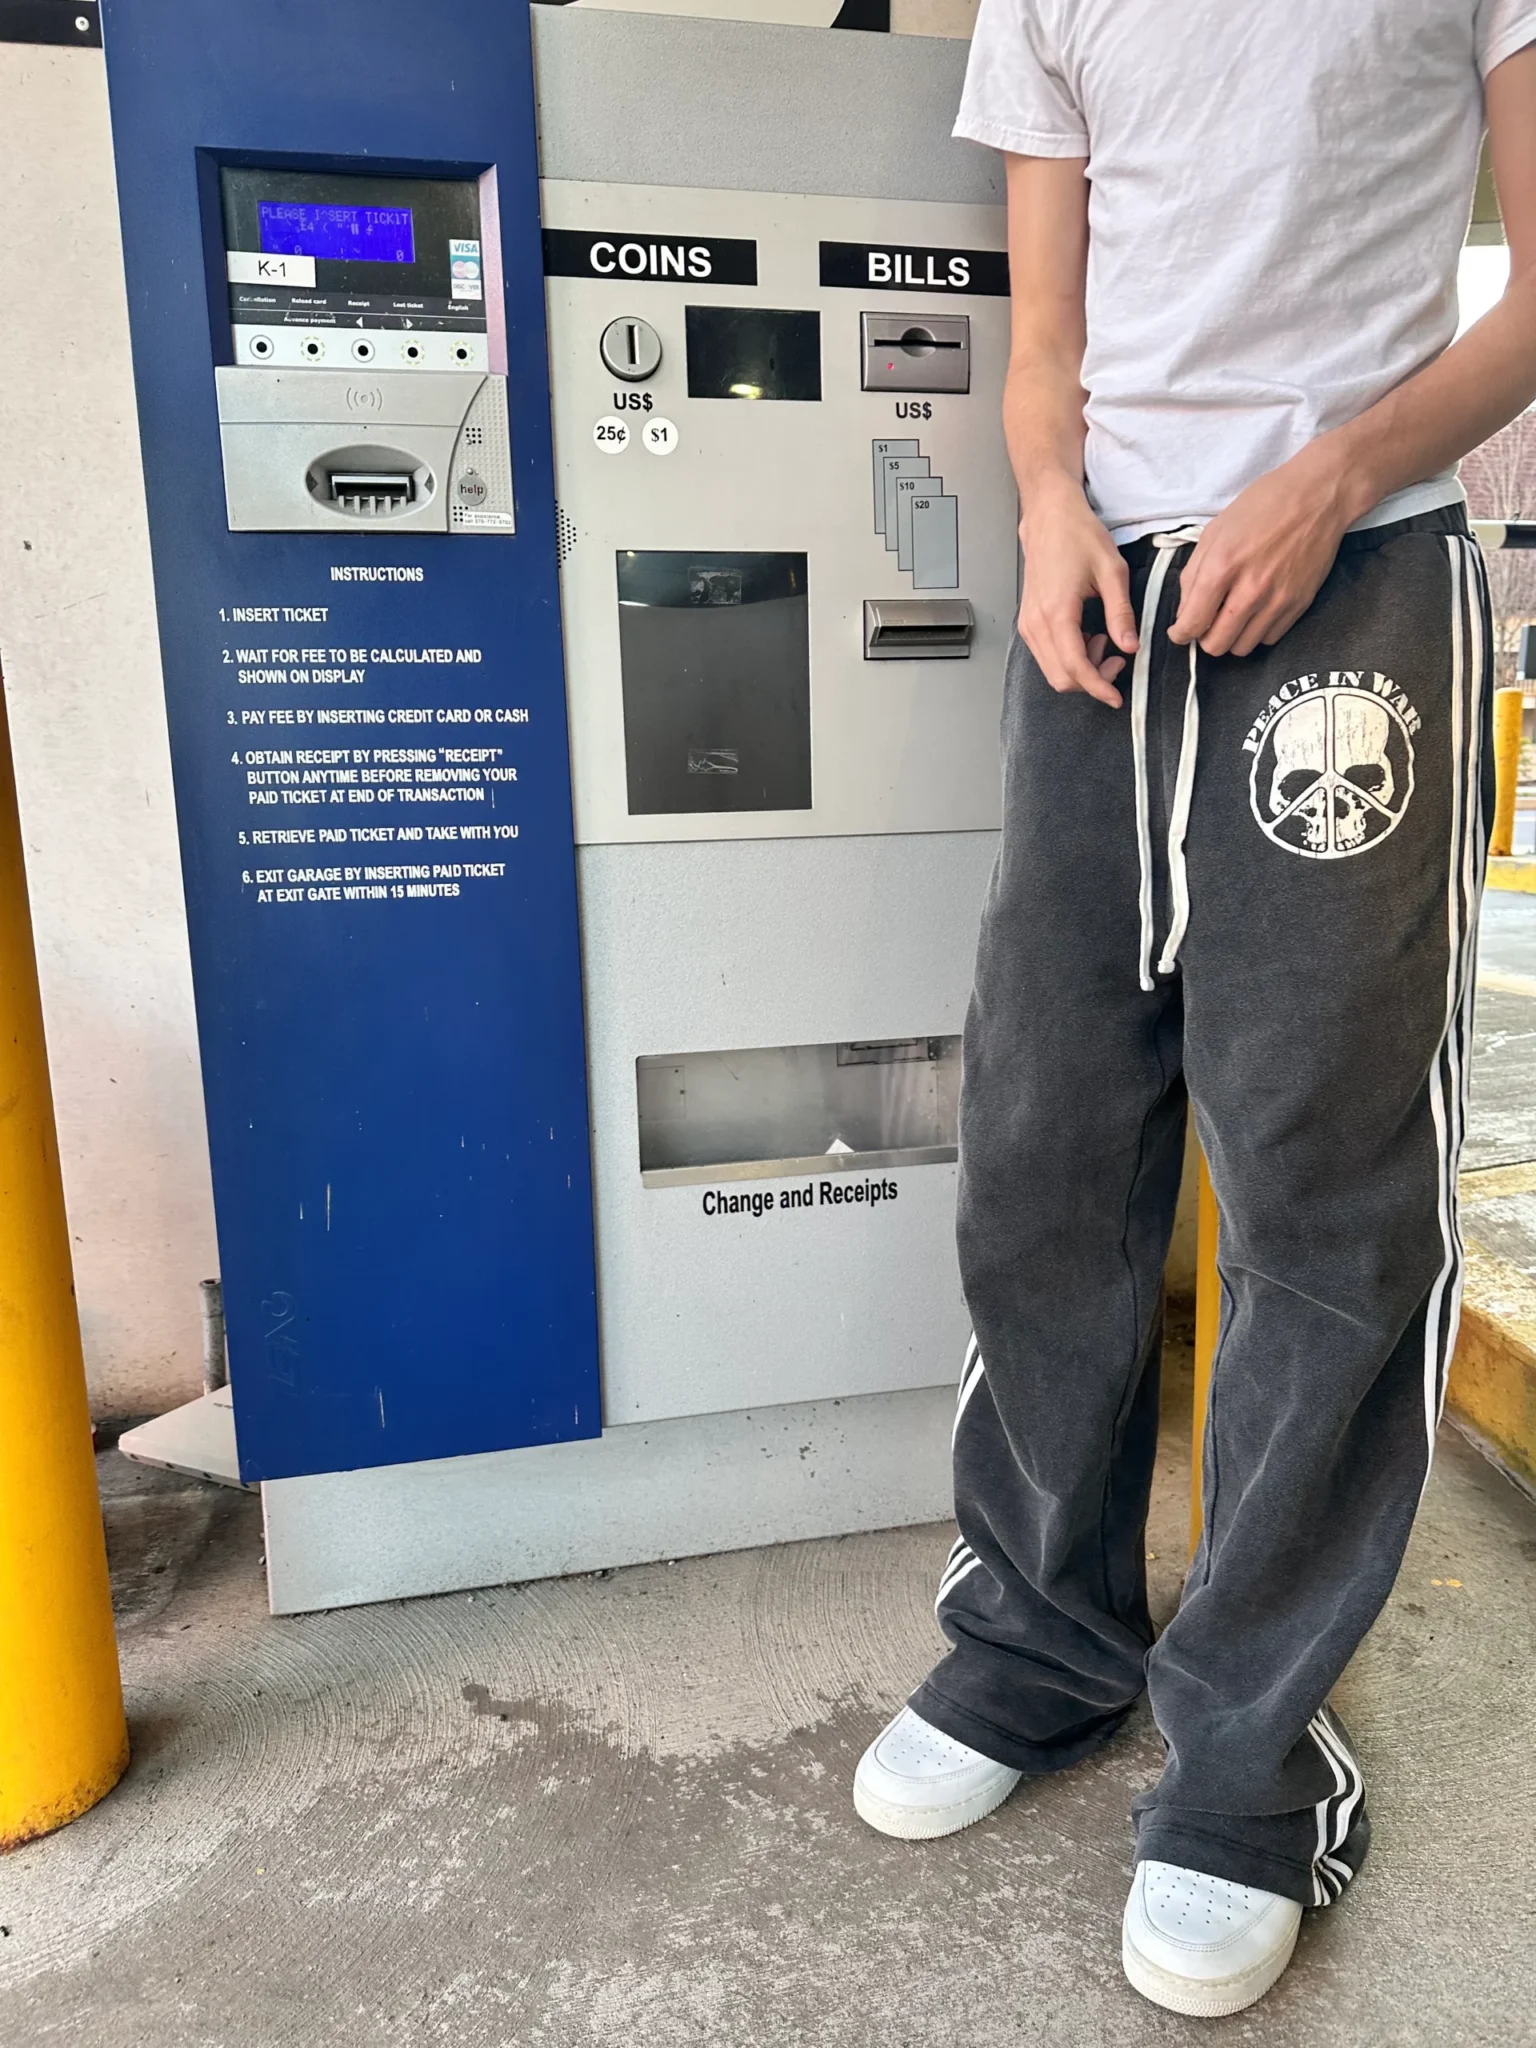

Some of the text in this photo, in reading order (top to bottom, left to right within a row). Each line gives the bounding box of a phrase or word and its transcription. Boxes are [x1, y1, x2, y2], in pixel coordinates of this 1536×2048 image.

[261, 206, 306, 220] PLEASE
[454, 243, 478, 253] VISA
[589, 241, 712, 278] COINS
[258, 260, 287, 277] K-1
[868, 252, 970, 287] BILLS
[613, 391, 653, 413] US$
[895, 401, 932, 421] US$
[596, 425, 626, 442] 25¢
[651, 427, 668, 443] $1
[878, 444, 888, 453] $1
[889, 461, 900, 470] $5
[460, 484, 484, 496] help
[899, 481, 915, 490] $10
[914, 500, 930, 509] $20
[330, 566, 424, 582] INSTRUCTIONS
[218, 607, 329, 622] 1. INSERT TICKET
[221, 648, 482, 663] 2. WAIT FOR FEE TO BE CALCULATED AND
[237, 669, 366, 684] SHOWN ON DISPLAY
[226, 708, 529, 725] 3. PAY FEE BY INSERTING CREDIT CARD OR CASH
[1242, 670, 1422, 754] PEACE IN WAR
[230, 751, 244, 765] 4.
[245, 750, 294, 765] OBTAIN
[295, 749, 351, 764] RECEIPT
[352, 749, 371, 764] BY
[373, 748, 437, 763] PRESSING
[246, 767, 518, 785] BUTTON ANYTIME BEFORE REMOVING YOUR
[248, 787, 485, 805] PAID TICKET AT END OF TRANSACTION
[238, 825, 519, 846] 5. RETRIEVE PAID TICKET AND TAKE WITH YOU
[241, 863, 506, 885] 6. EXIT GARAGE BY INSERTING PAID TICKET
[257, 882, 461, 903] AT EXIT GATE WITHIN 15 MINUTES
[702, 1178, 898, 1218] Change and Receipts
